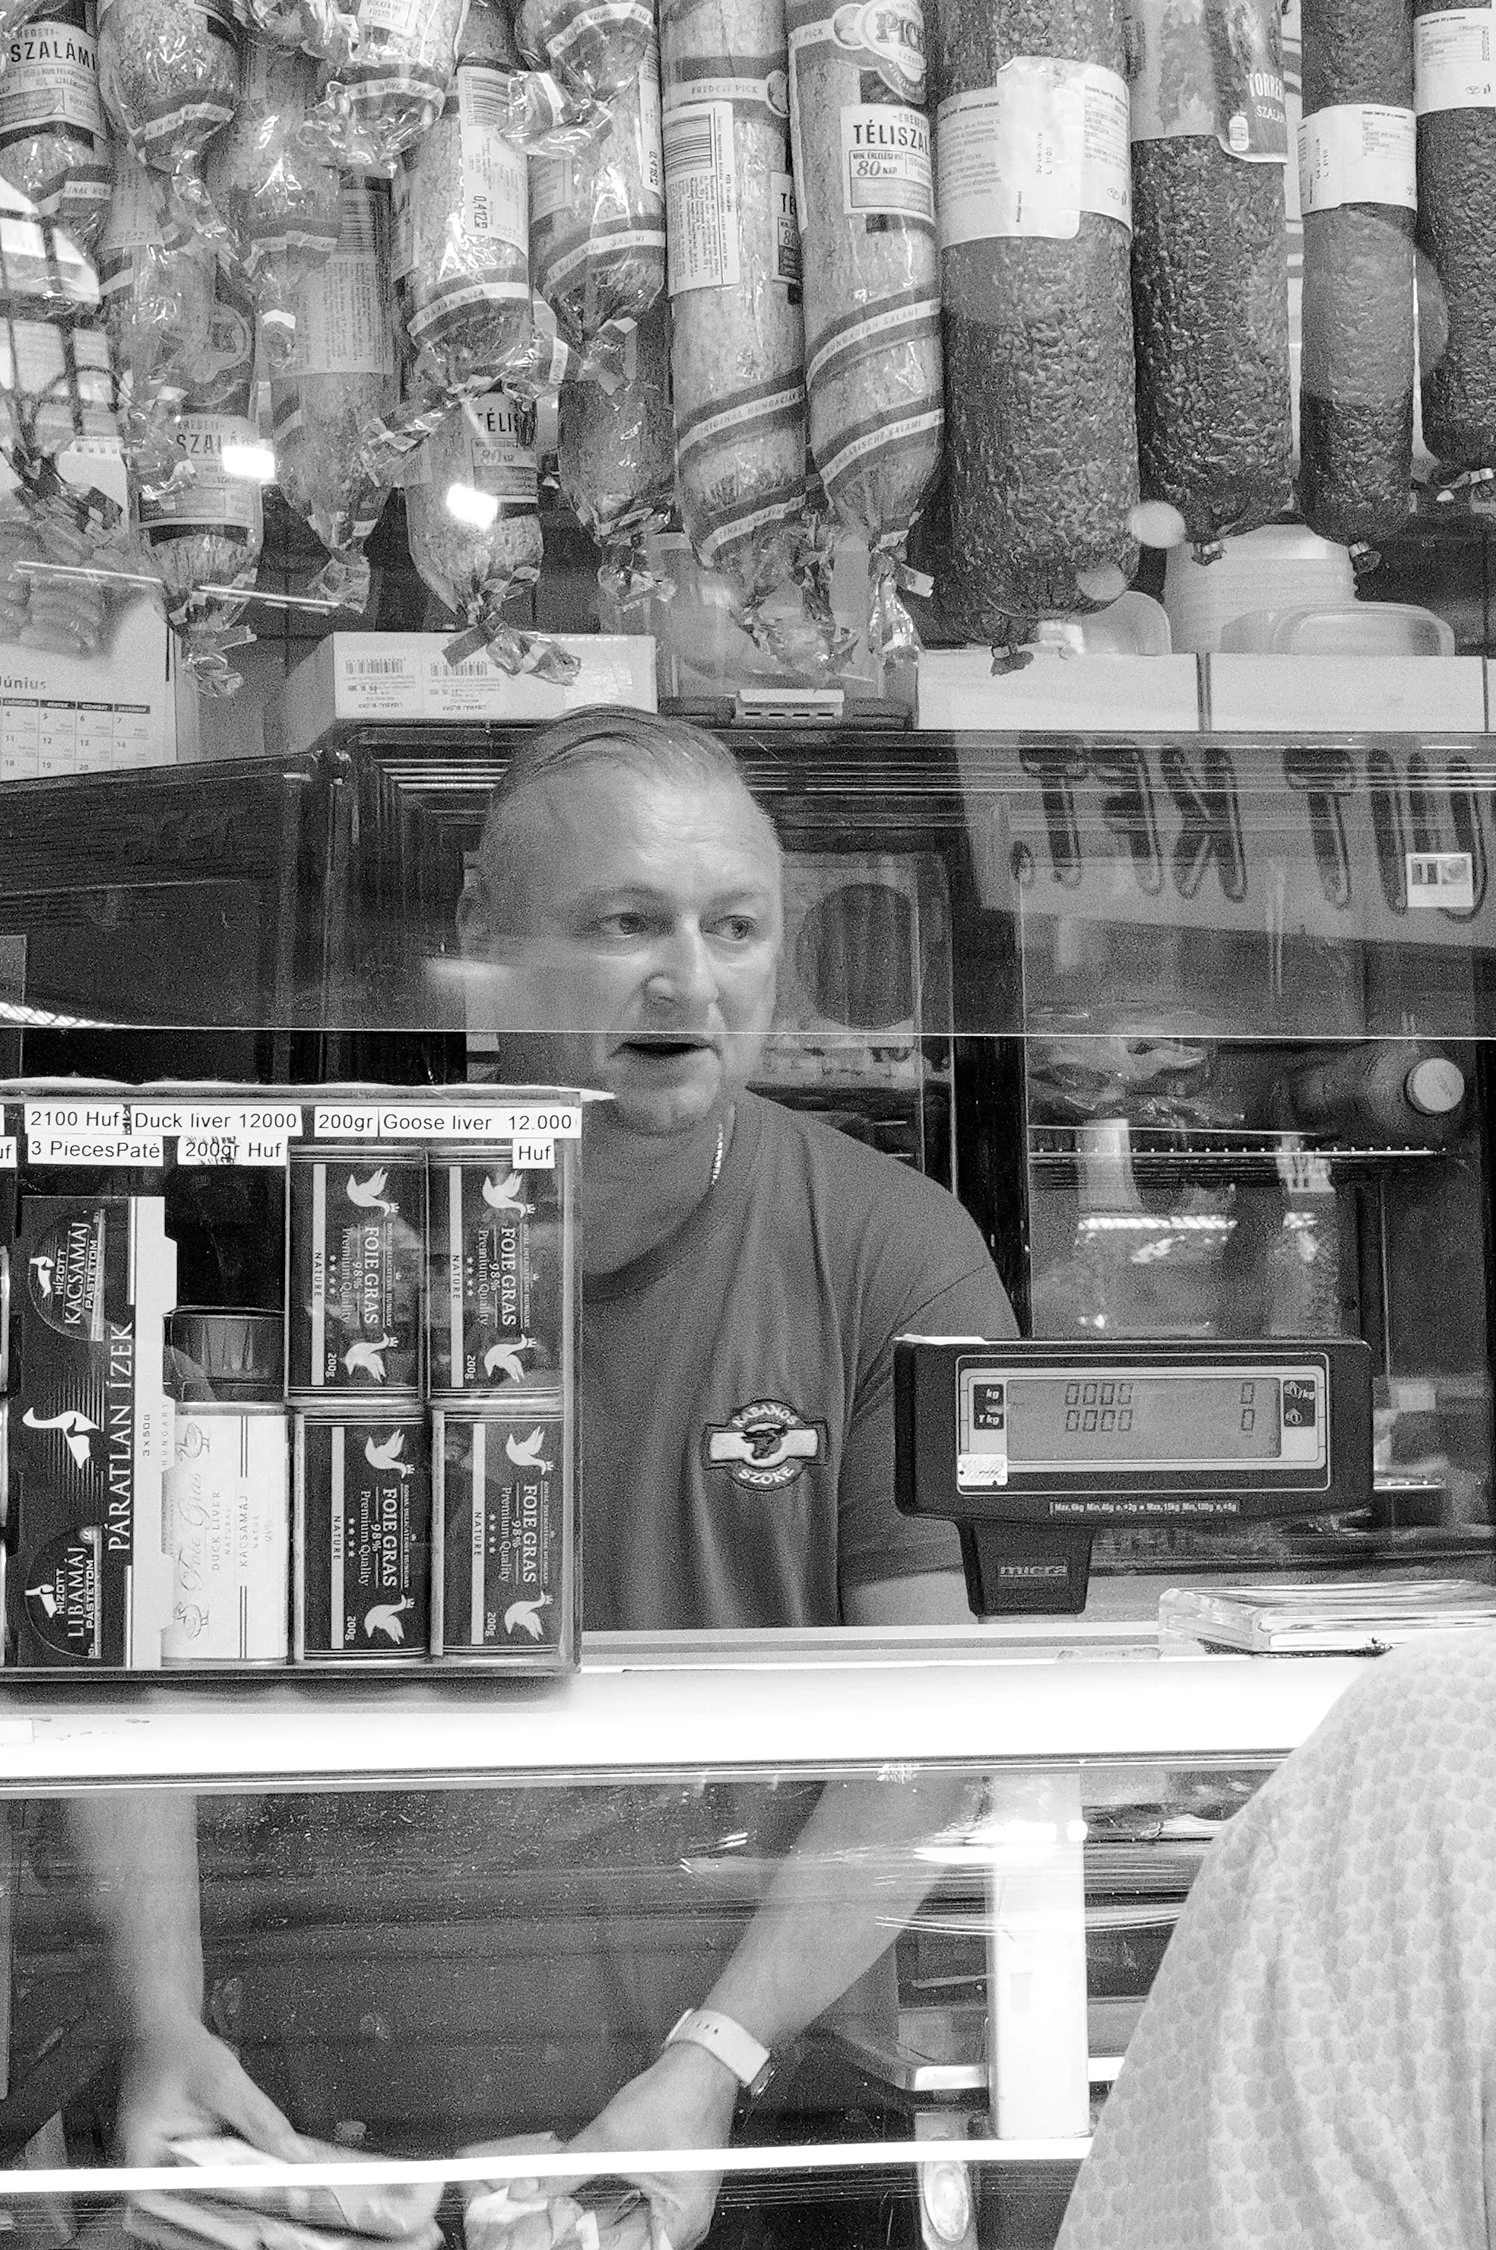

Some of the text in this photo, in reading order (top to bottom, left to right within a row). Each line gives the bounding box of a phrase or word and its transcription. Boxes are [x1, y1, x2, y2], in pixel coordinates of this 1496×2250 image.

[10, 38, 96, 71] SZALÁMI
[857, 160, 880, 176] 80
[30, 1111, 120, 1127] 2100 Huf
[135, 1112, 297, 1128] Duck liver 12000
[318, 1114, 373, 1132] 200gr
[383, 1113, 572, 1130] Goose liver 12.000
[31, 1140, 42, 1155] 3
[185, 1141, 281, 1161] 200gr Huf
[518, 1145, 552, 1161] Huf
[64, 1222, 91, 1324] KACSAMÁJ
[314, 1252, 323, 1297] NATURE
[341, 1228, 352, 1324] Premium Quality
[352, 1261, 363, 1289] 98%
[364, 1227, 379, 1325] FOIE GRAS
[453, 1254, 461, 1300] NATURE
[478, 1230, 489, 1326] Premium Quality
[489, 1262, 500, 1291] 98%
[501, 1227, 517, 1326] FOIE GRAS
[325, 1353, 337, 1378] 200g
[464, 1355, 476, 1380] 200g
[985, 1388, 1000, 1400] kg
[1240, 1382, 1255, 1404] 0
[732, 1404, 800, 1427] KABANOS
[978, 1414, 1000, 1425] T kg
[1240, 1408, 1255, 1431] 0
[104, 1321, 133, 1551] PÁRATLAN ÍZEK
[212, 1490, 220, 1571] DUCK LIVER
[359, 1490, 372, 1586] Premium Quality
[371, 1523, 381, 1552] 98%
[382, 1488, 397, 1587] FOIE GRAS
[474, 1511, 482, 1556] NATURE
[499, 1487, 512, 1582] Premium Quality
[511, 1520, 521, 1548] 98%
[523, 1485, 537, 1583] FOIE GRAS
[64, 1547, 88, 1637] LIBAMÁJ
[83, 1559, 94, 1629] PÁSTÉTOM
[345, 1616, 356, 1641] 200g
[485, 1612, 496, 1637] 200g
